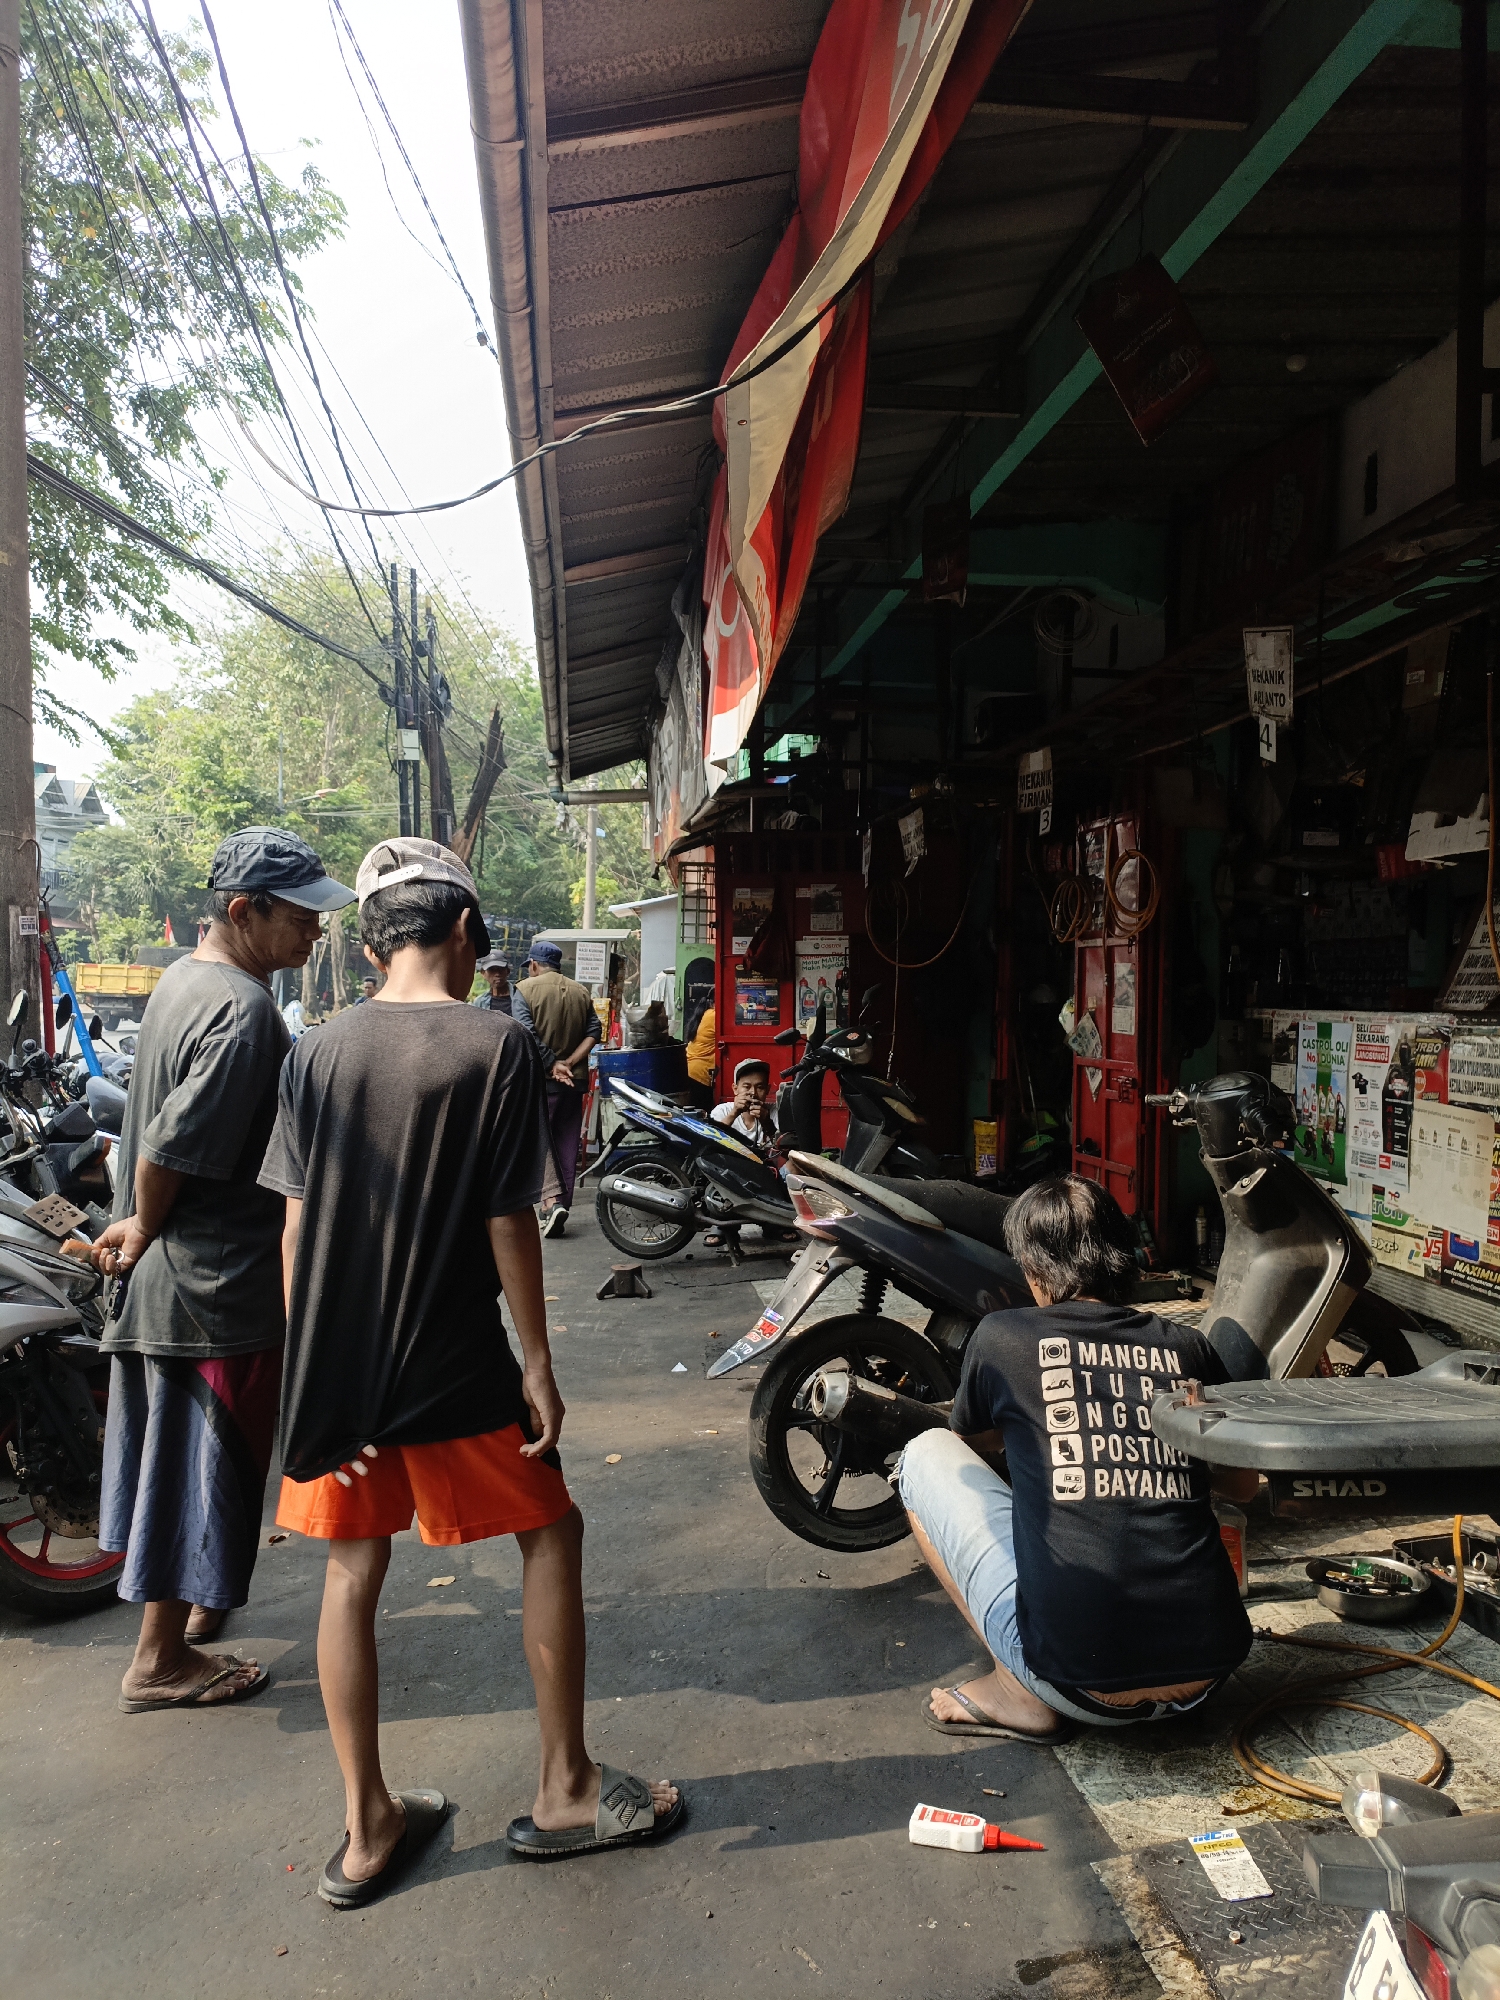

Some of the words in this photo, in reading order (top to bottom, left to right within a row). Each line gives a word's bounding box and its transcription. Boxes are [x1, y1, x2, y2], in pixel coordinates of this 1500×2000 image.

[1251, 669, 1285, 684] MEKANIK
[1260, 723, 1272, 752] 4
[1020, 770, 1052, 790] MEKANIK
[1020, 789, 1051, 807] FIRMAN
[1042, 810, 1050, 831] 3
[1356, 1023, 1369, 1033] BELI
[1302, 1038, 1333, 1051] CASTROL
[1336, 1042, 1349, 1053] OLI
[1356, 1033, 1390, 1044] SEKARANG
[1416, 1043, 1442, 1053] URBO
[1321, 1053, 1345, 1066] DUNIA
[1078, 1341, 1181, 1375] MANGAN
[1292, 1479, 1387, 1497] SHAD
